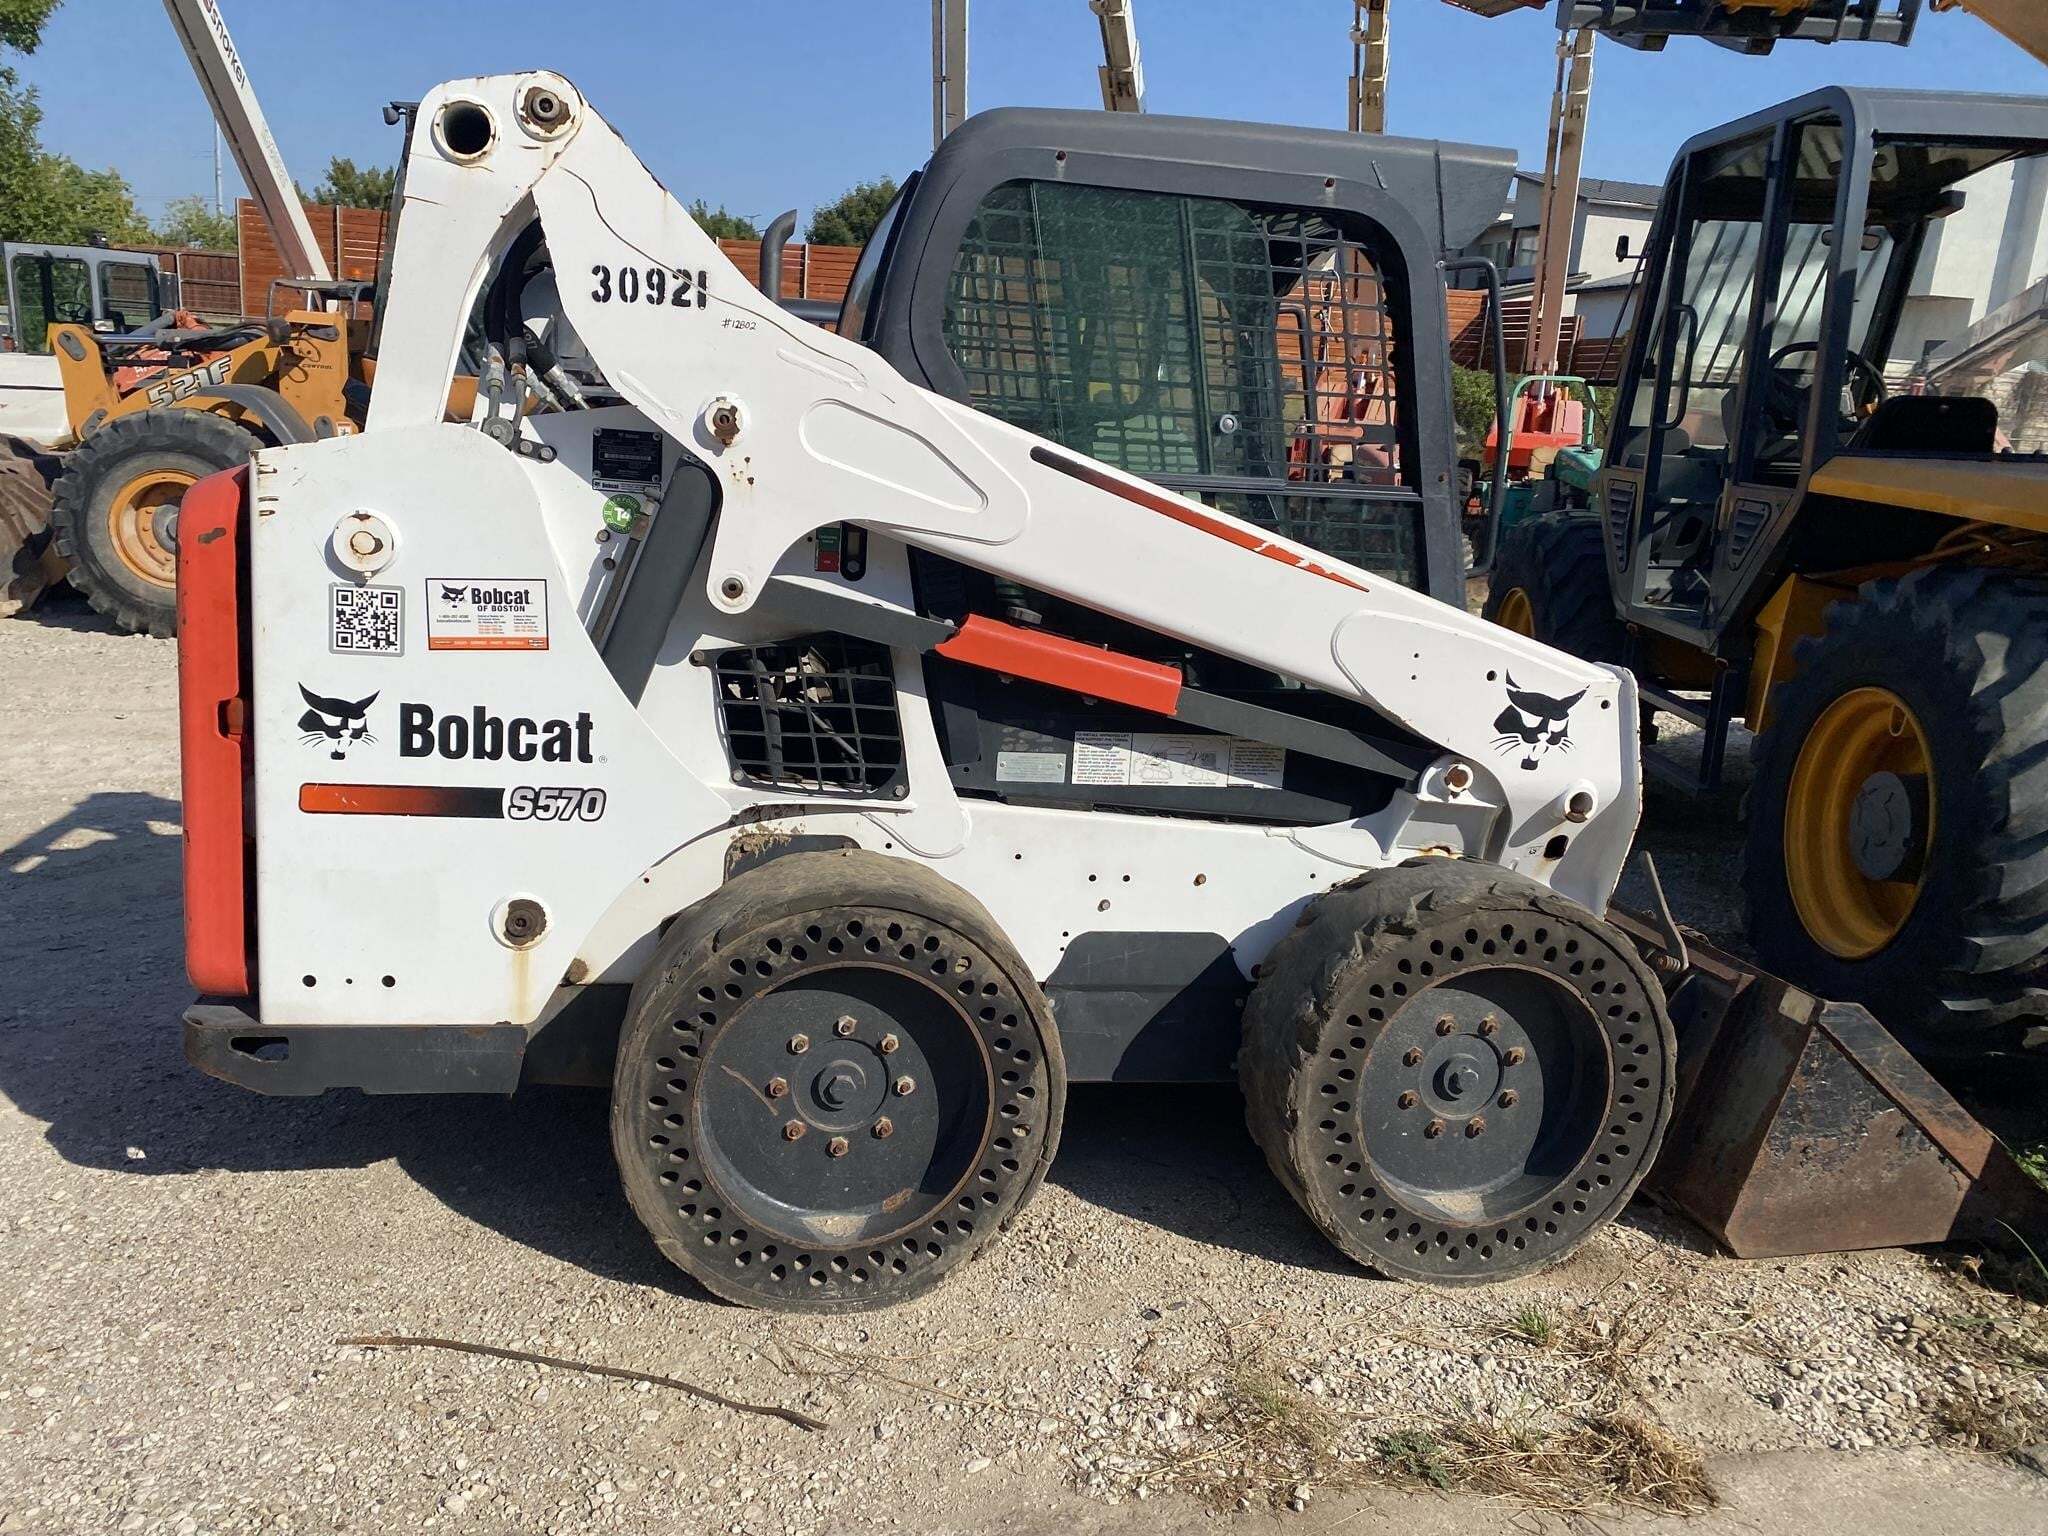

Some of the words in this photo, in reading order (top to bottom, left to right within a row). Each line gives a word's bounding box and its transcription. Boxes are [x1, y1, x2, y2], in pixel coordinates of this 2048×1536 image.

[211, 8, 246, 90] snorkel
[591, 265, 707, 310] 30921
[147, 354, 232, 407] 521F
[471, 587, 531, 605] Bobcat
[400, 702, 593, 763] Bobcat
[508, 786, 607, 822] S570
